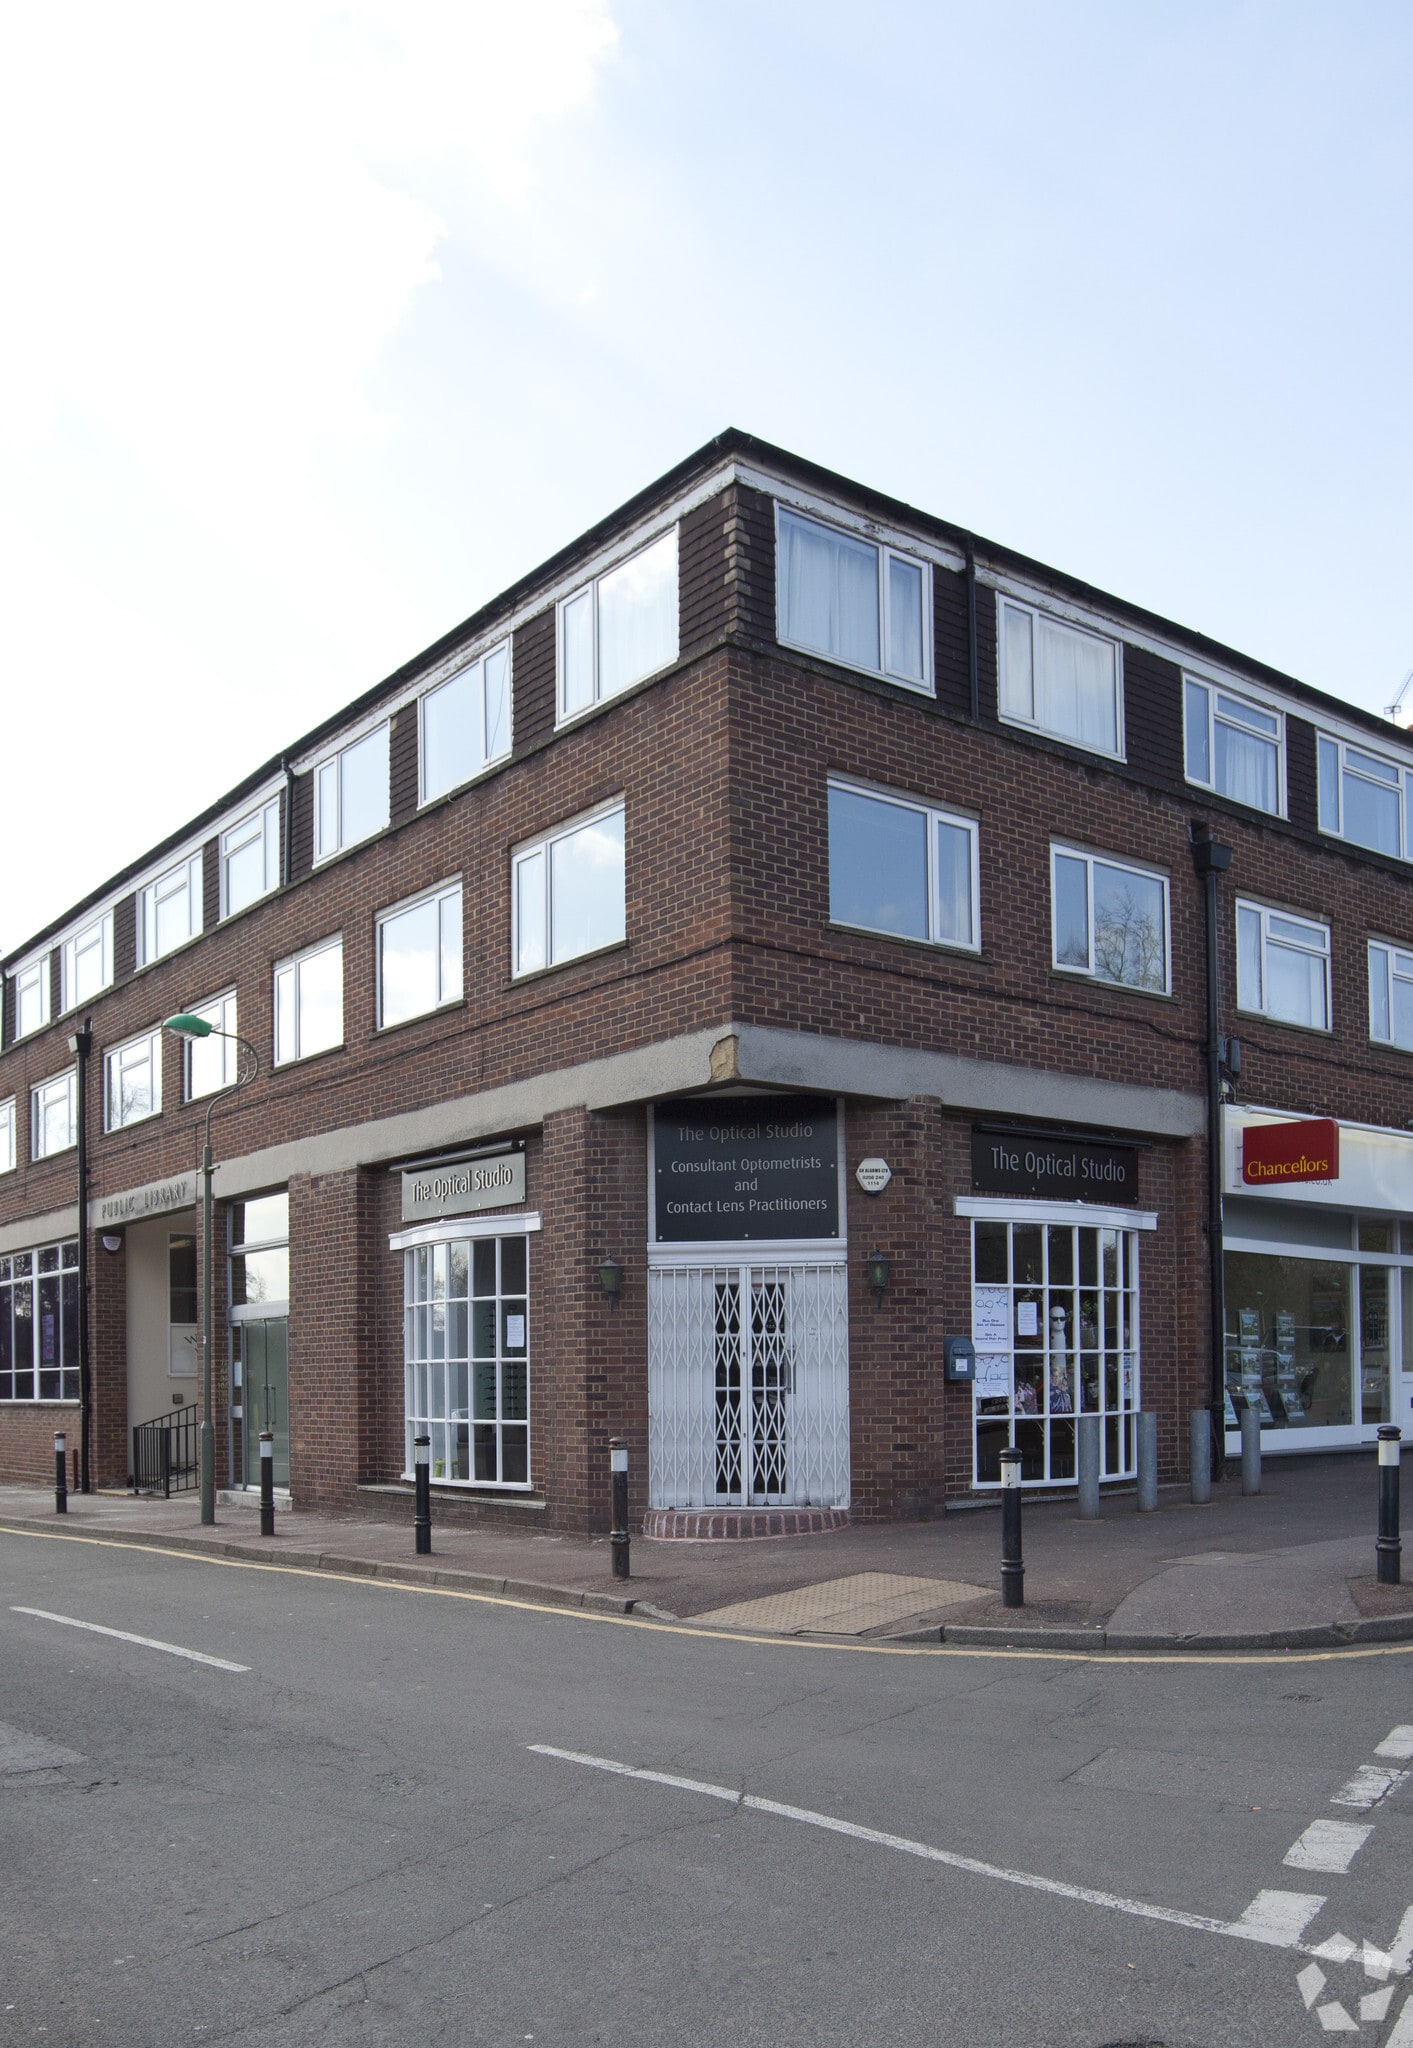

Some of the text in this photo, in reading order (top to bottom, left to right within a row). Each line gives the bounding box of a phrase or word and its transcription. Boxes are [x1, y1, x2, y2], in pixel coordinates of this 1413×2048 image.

[678, 1122, 813, 1144] The Optical Studio
[671, 1156, 822, 1173] Consultant Optometrists
[991, 1145, 1126, 1182] The Optical Studio
[1247, 1155, 1329, 1177] Chancellors
[411, 1164, 513, 1202] The Optical Studio
[734, 1178, 758, 1191] and
[102, 1181, 187, 1218] PUBLIC LIBRARY
[666, 1198, 828, 1214] Contact Lens Practitioners
